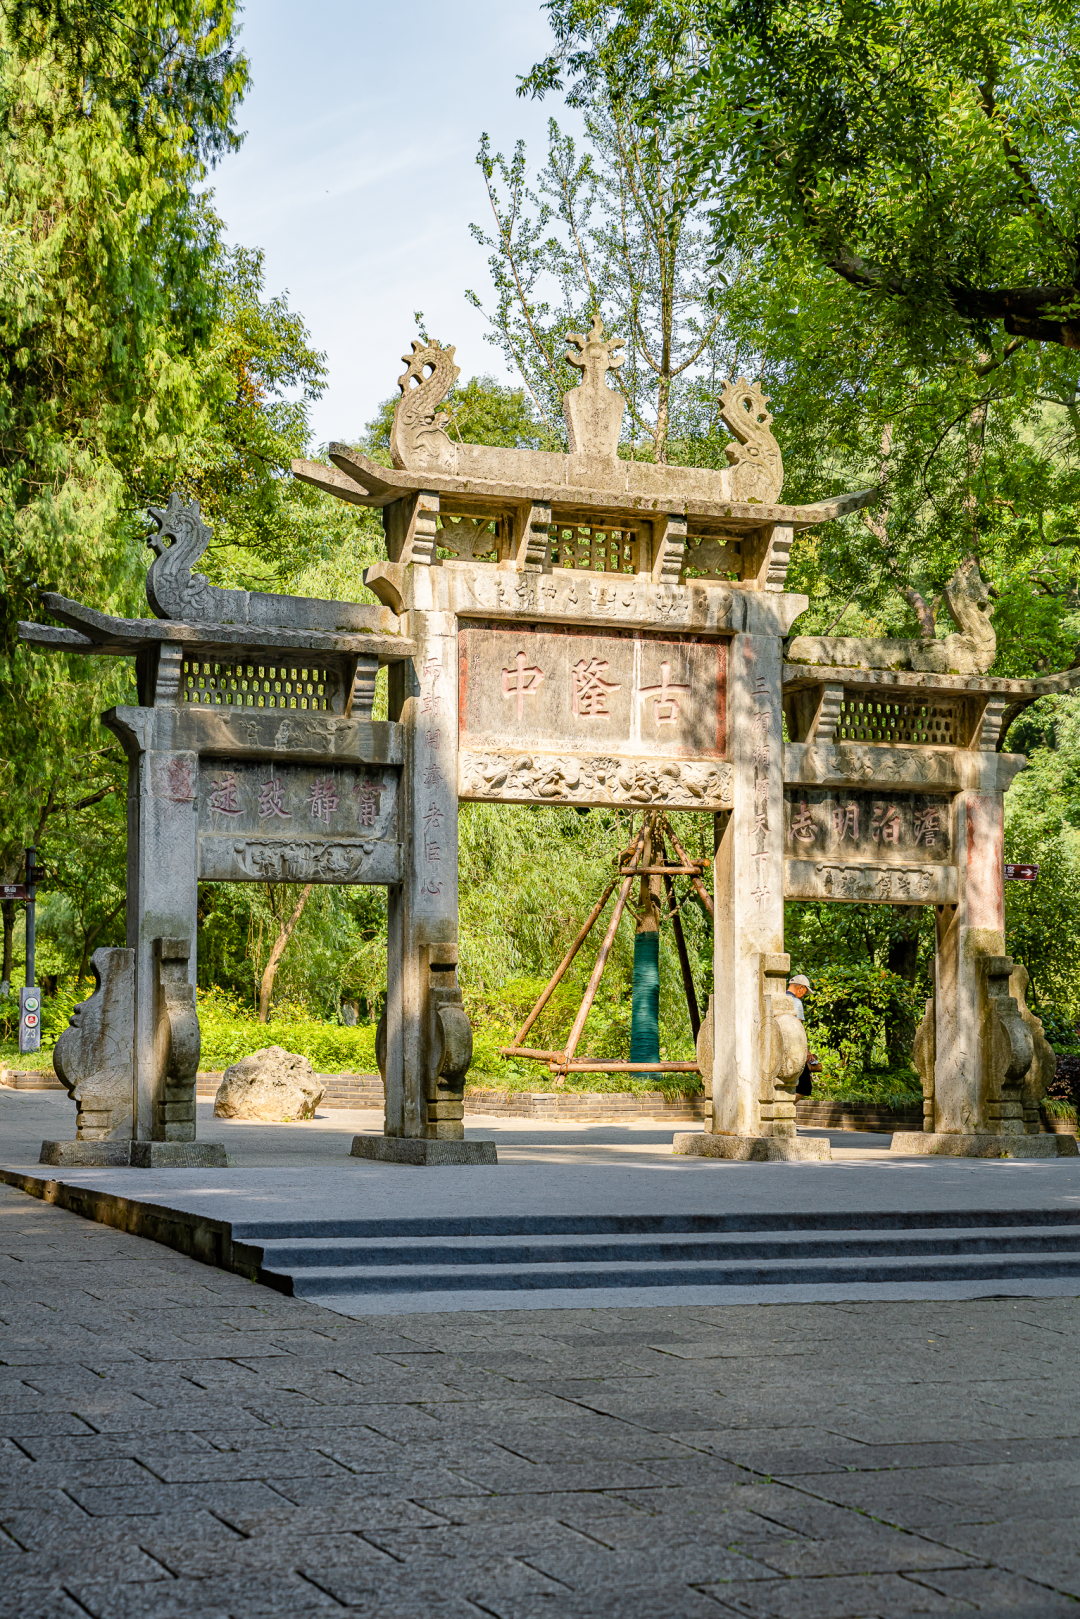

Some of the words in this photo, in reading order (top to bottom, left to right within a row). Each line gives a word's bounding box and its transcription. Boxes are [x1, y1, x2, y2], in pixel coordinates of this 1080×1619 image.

[501, 650, 692, 728] 古隆中
[25, 1028, 36, 1039] 23
